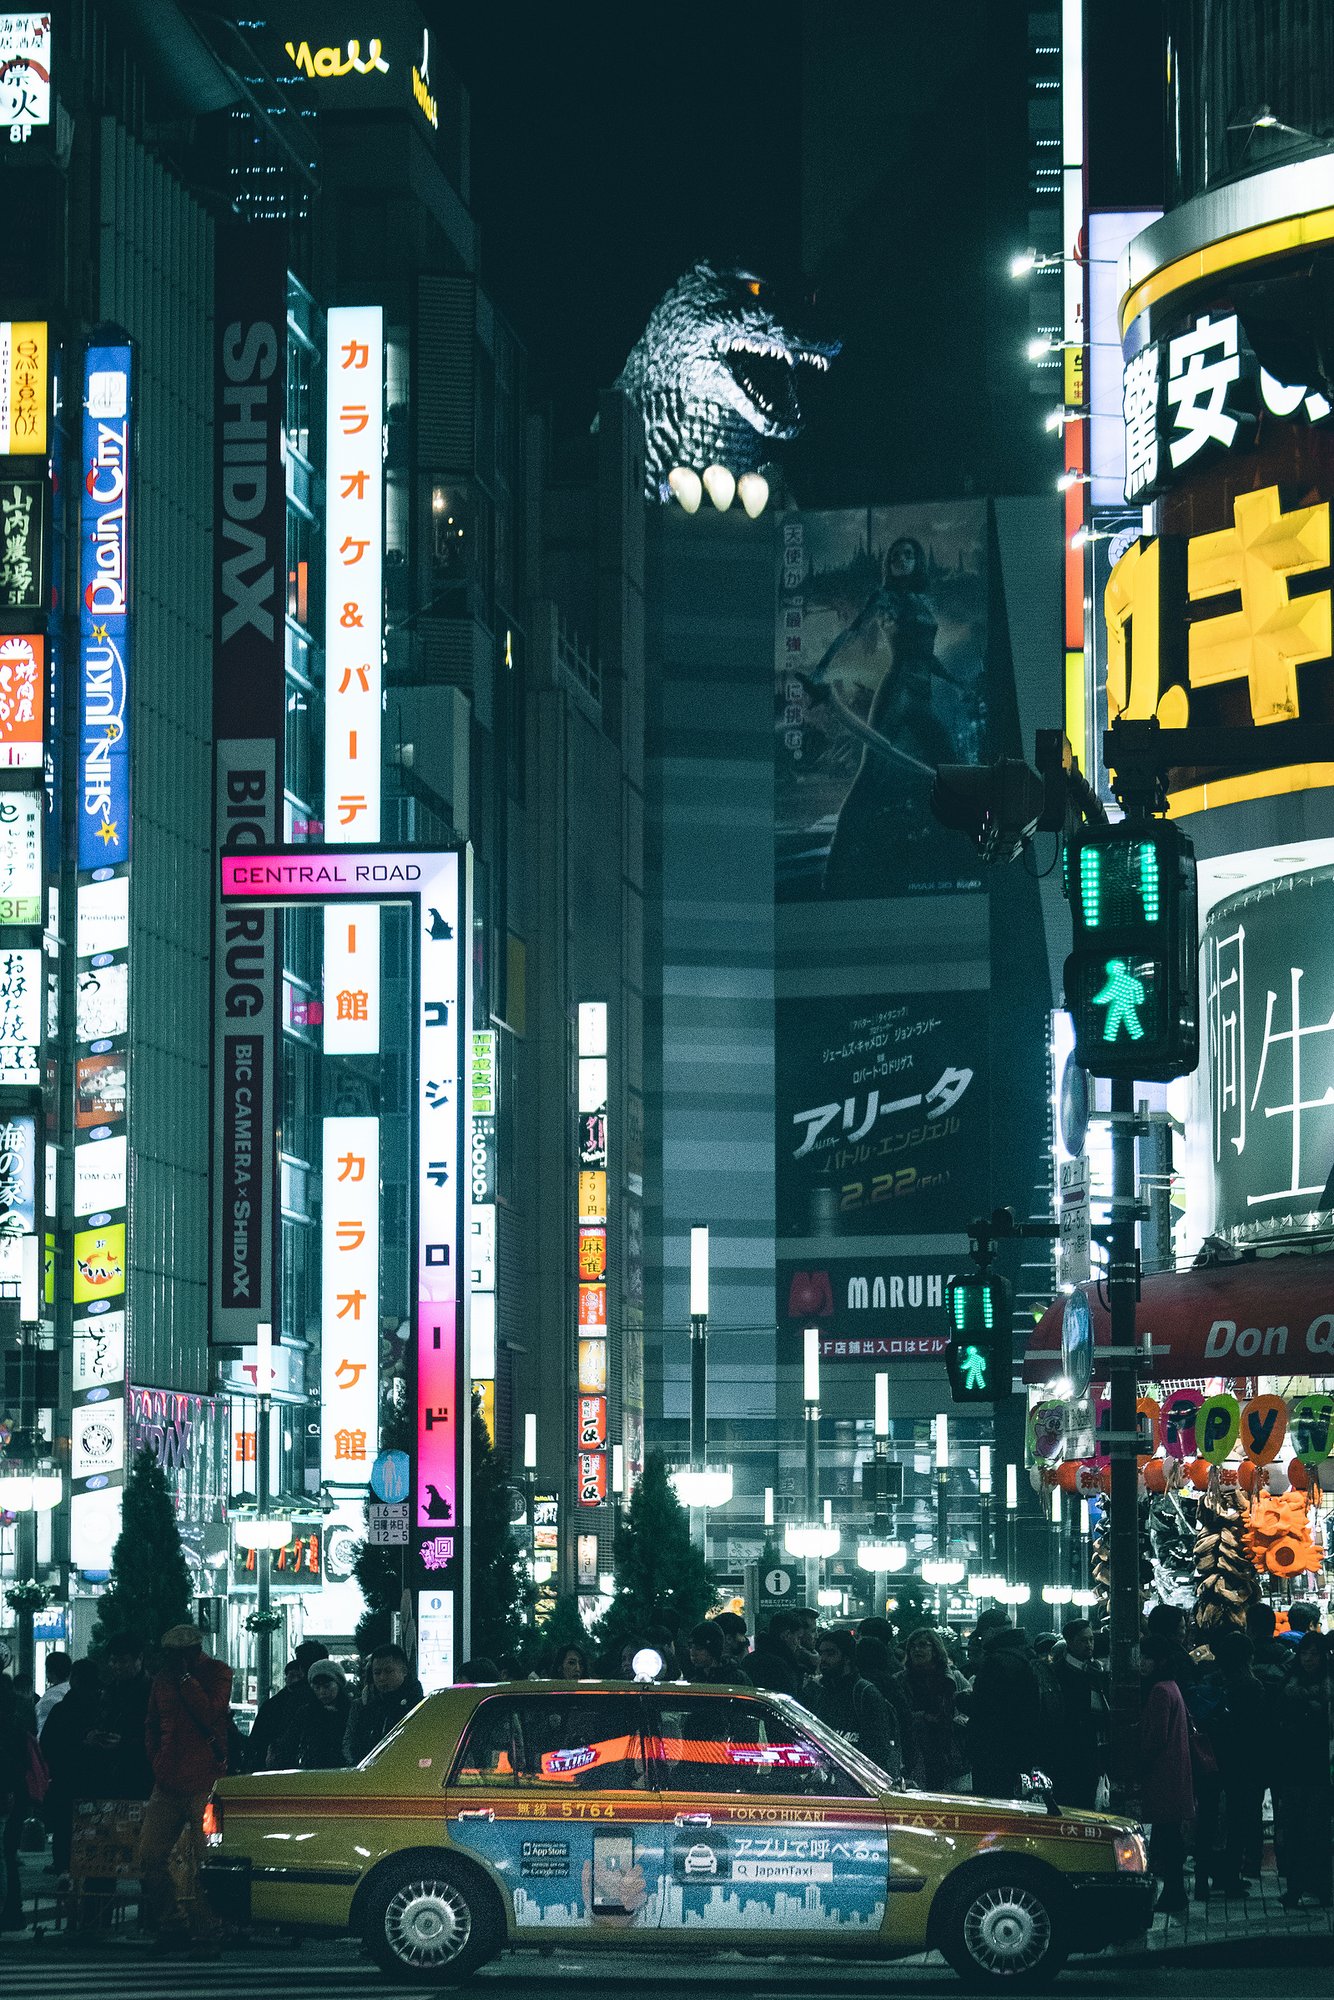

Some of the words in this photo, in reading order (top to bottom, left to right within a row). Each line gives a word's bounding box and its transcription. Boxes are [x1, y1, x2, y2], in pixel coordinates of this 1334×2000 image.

[10, 125, 32, 142] 8F
[15, 338, 39, 436] 鳥貴族
[222, 320, 277, 643] SHIDAX
[0, 485, 33, 592] 山内農場
[8, 591, 25, 604] 5F
[85, 646, 123, 816] SHINJUKU
[233, 866, 347, 885] CENTRAL
[355, 863, 422, 881] ROAD
[0, 899, 28, 919] 3F
[226, 905, 265, 1018] RUG
[234, 1043, 253, 1082] BIC
[793, 1066, 974, 1160] アリータ
[234, 1087, 254, 1187] CAMERA
[0, 1122, 27, 1208] 海の家
[78, 1172, 100, 1181] TOM
[103, 1171, 124, 1181] CAT
[424, 999, 456, 1431] ゴジラロード
[233, 1199, 252, 1297] SHIDAX
[581, 1238, 603, 1274] 麻雀
[333, 1152, 369, 1462] カラオケ館
[847, 1273, 956, 1309] MARUH
[1204, 1319, 1289, 1359] Don
[376, 1505, 408, 1517] 16-5
[376, 1530, 408, 1542] 12-5
[516, 1803, 548, 1817] 無線
[561, 1803, 616, 1818] 5764
[728, 1807, 777, 1820] TOKYO
[780, 1810, 826, 1822] HIKARI
[896, 1812, 962, 1829] TAXI
[532, 1847, 546, 1857] App
[546, 1847, 567, 1856] Store
[734, 1837, 880, 1860] アプリで呼べる。
[754, 1865, 814, 1878] JapanTaxi
